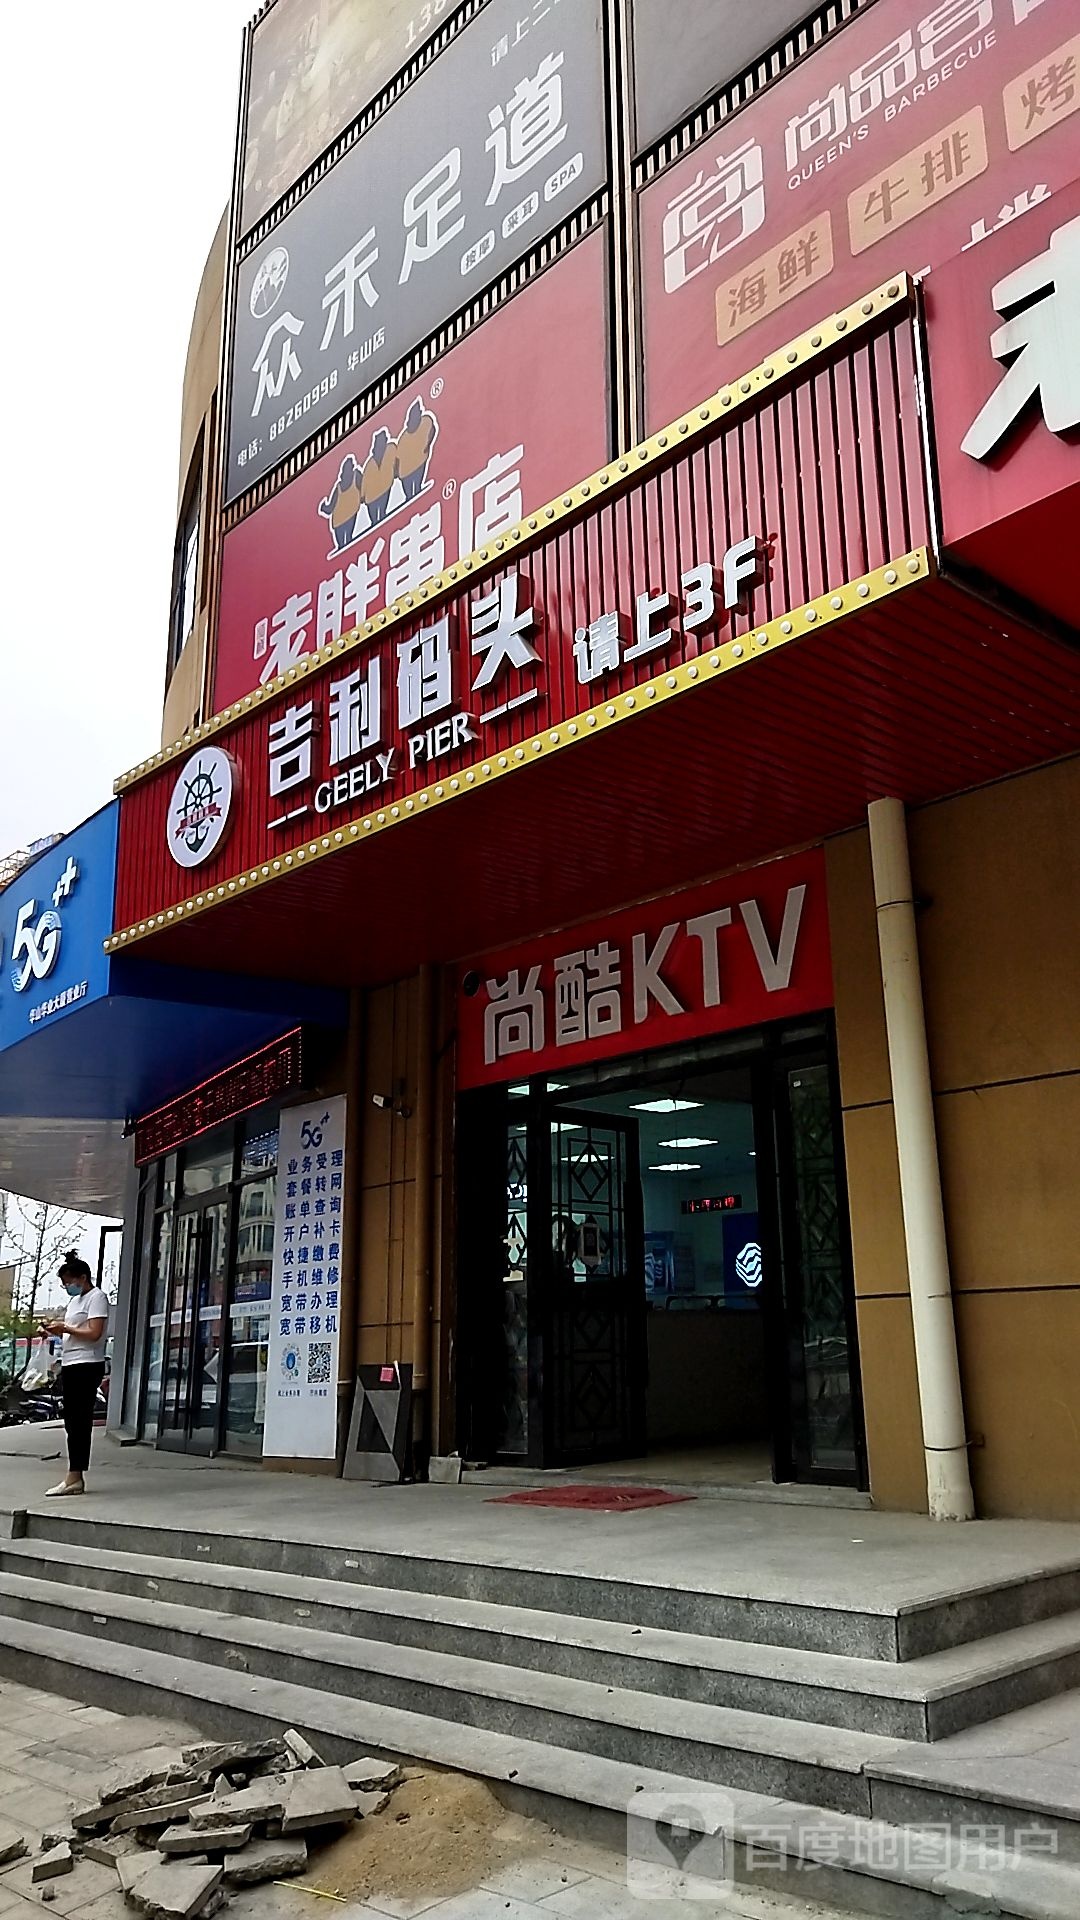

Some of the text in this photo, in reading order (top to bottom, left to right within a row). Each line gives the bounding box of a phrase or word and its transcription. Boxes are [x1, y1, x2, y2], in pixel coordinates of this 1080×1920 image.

[491, 0, 561, 67] 请上二
[787, 29, 997, 190] QUEEN'S BARBECUE
[551, 164, 576, 192] SPA
[728, 231, 820, 328] 海鲜
[864, 130, 971, 224] 牛排
[1021, 56, 1077, 129] 烤
[252, 51, 568, 417] 众禾足道
[269, 369, 338, 442] 88260998
[347, 326, 386, 371] 华山店
[573, 535, 757, 685] 请上3F
[269, 572, 542, 797] 吉利码头
[314, 712, 474, 814] GEELY PIER
[484, 884, 806, 1066] 尚酷KTV
[286, 1173, 342, 1198] 套餐转网
[287, 1149, 343, 1176] 业务受理
[284, 1220, 341, 1243] 开户补卡
[285, 1196, 341, 1220] 账单查询
[281, 1266, 339, 1289] 手机维修
[282, 1243, 340, 1266] 快捷缴费
[280, 1290, 338, 1312] 宽带办理
[279, 1314, 338, 1336] 宽带移机
